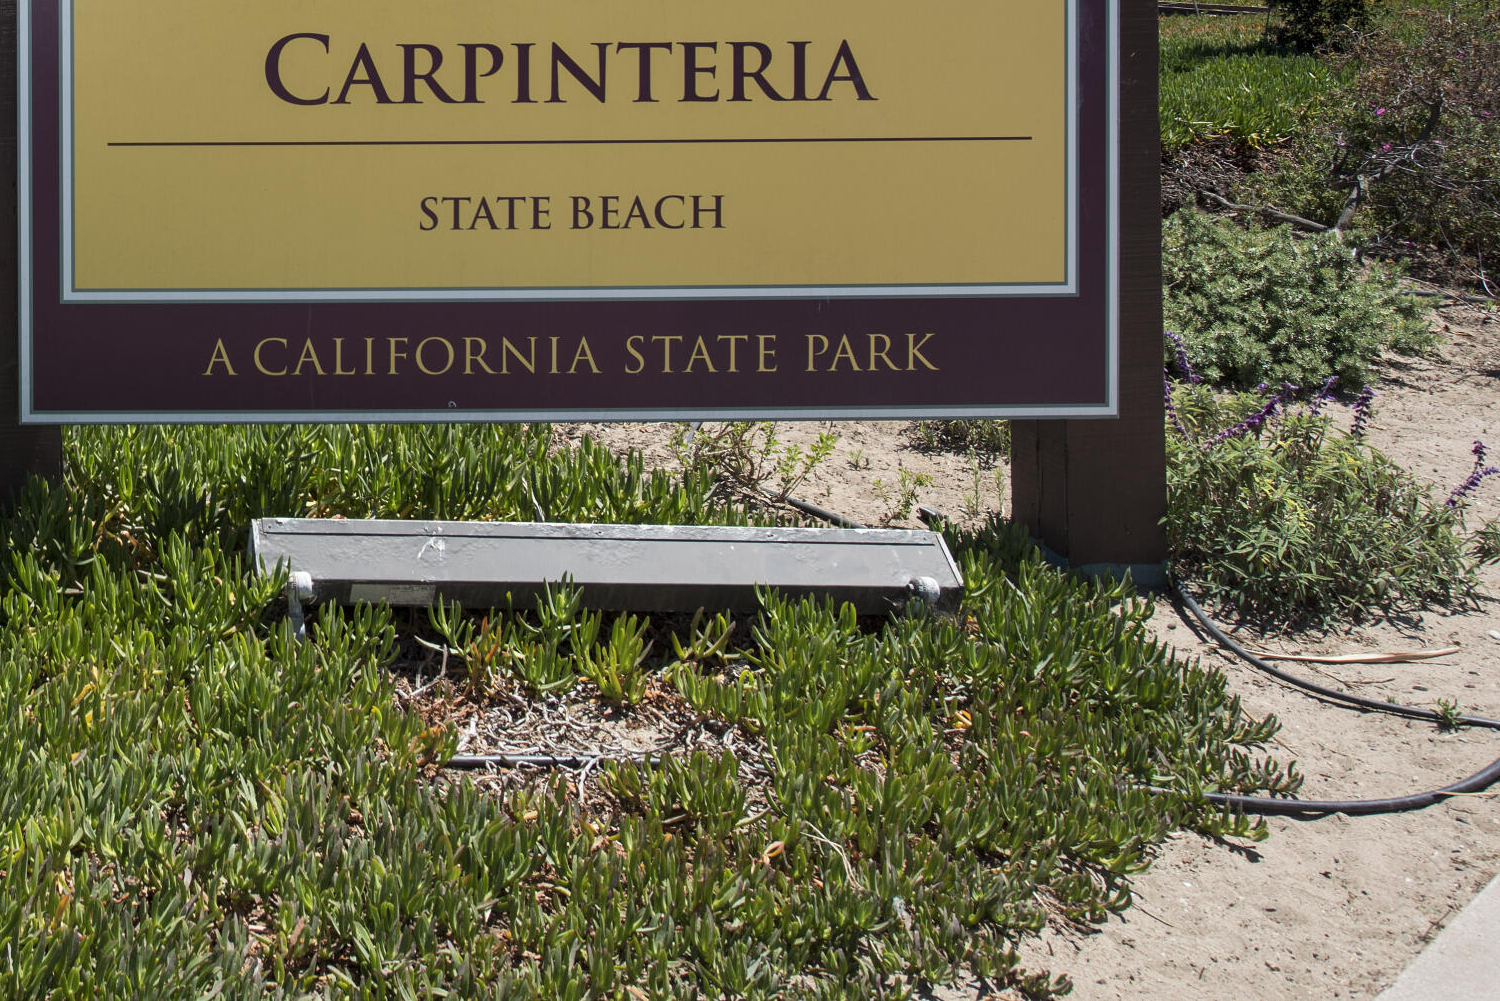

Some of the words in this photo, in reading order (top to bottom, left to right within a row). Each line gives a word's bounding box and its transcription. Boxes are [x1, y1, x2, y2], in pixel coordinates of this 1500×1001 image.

[419, 196, 552, 231] STATE
[569, 194, 726, 230] BEACH
[202, 337, 238, 377] A
[253, 335, 602, 376] CALIFORNIA
[624, 334, 778, 374] STATE
[804, 333, 940, 372] PARK
